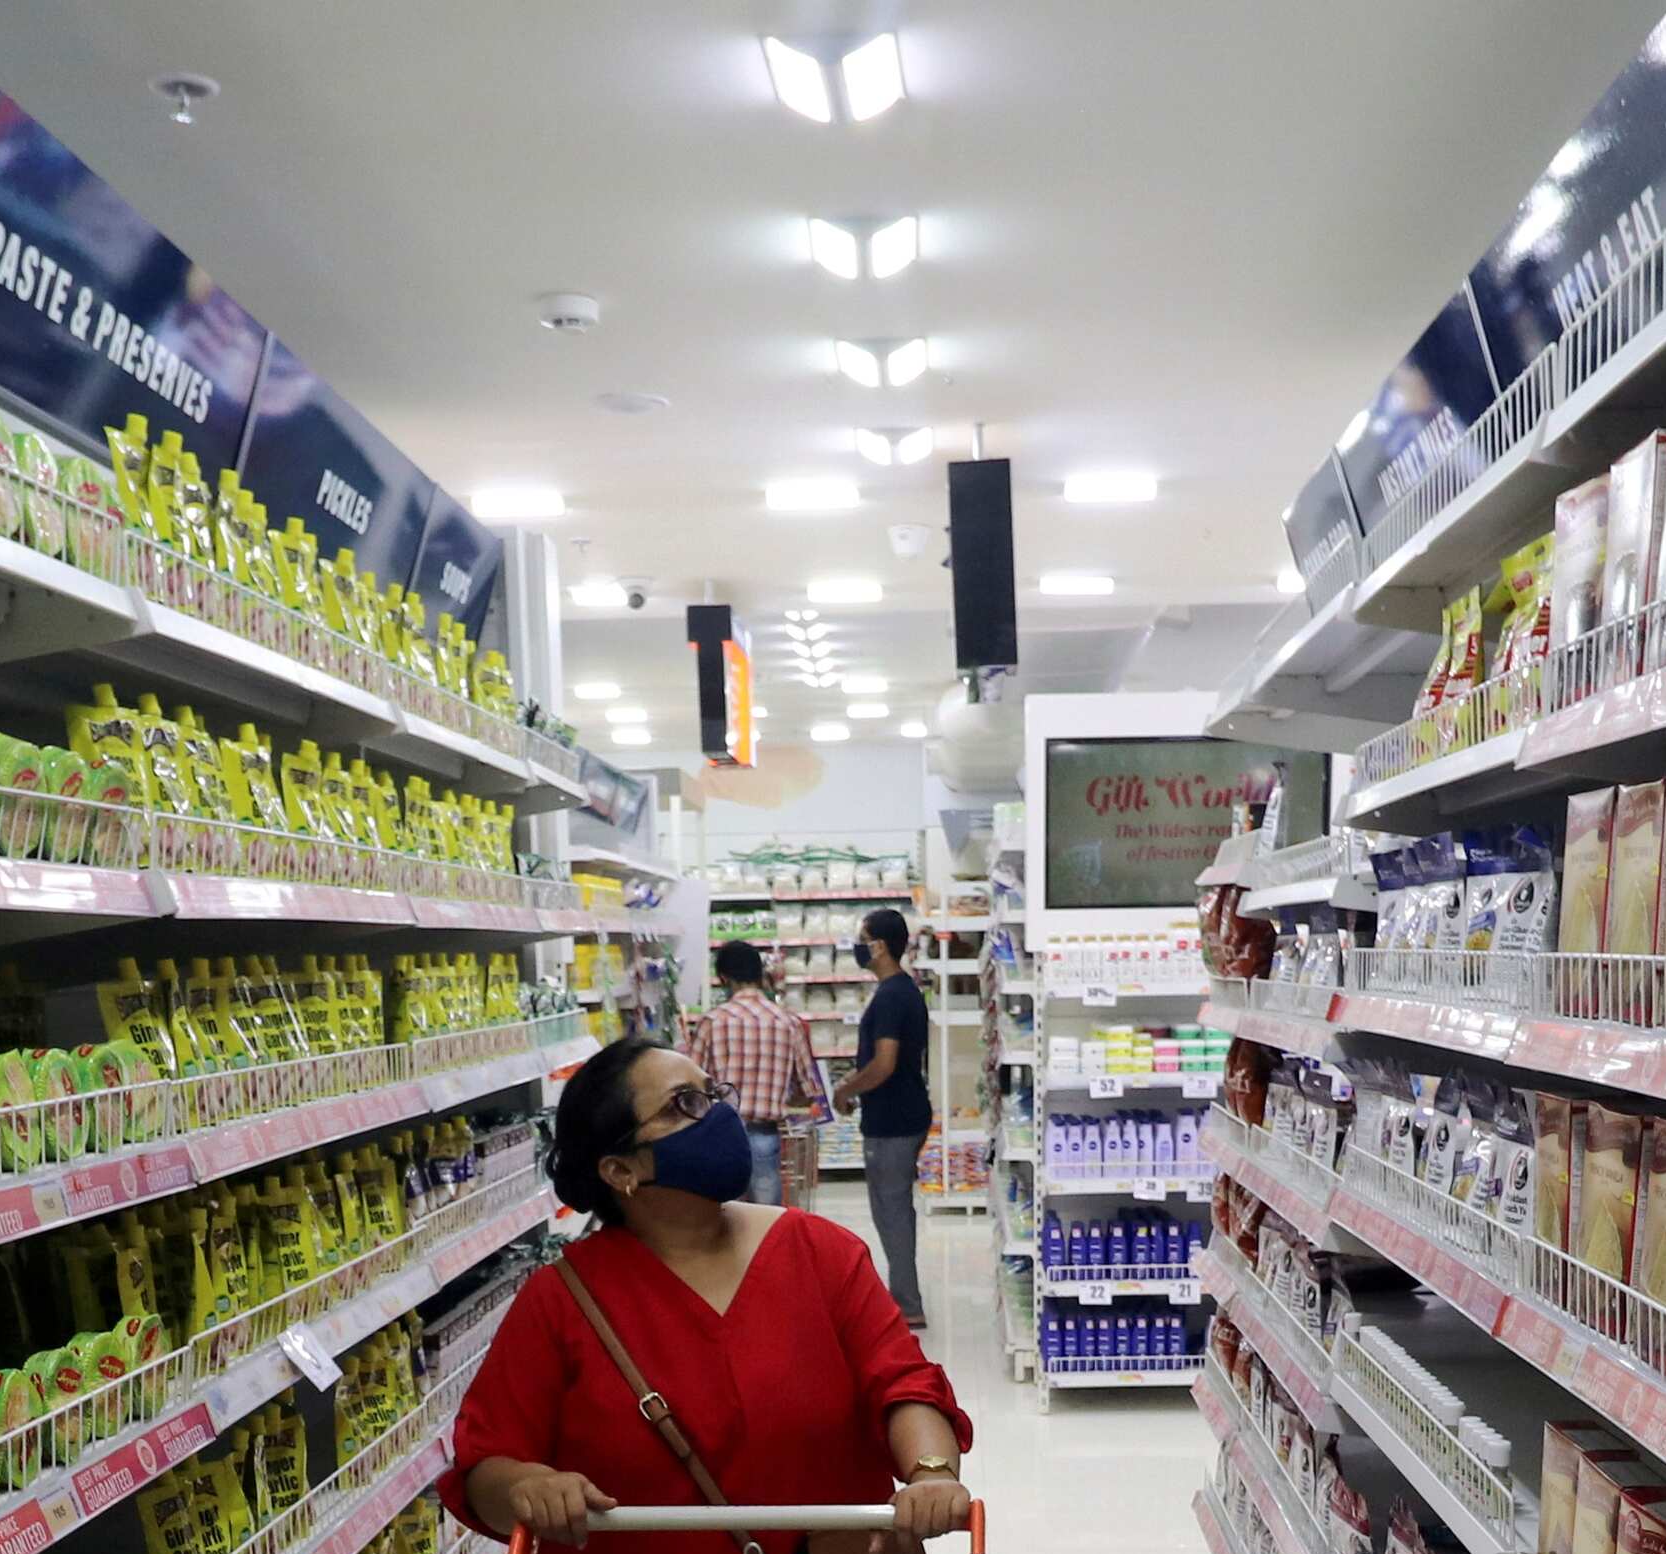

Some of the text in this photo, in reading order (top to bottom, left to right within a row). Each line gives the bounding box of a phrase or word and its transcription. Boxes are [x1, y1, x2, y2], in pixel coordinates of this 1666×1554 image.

[1600, 234, 1621, 283] &
[1617, 186, 1662, 266] EAT
[69, 285, 92, 339] &
[92, 300, 215, 425] PRESERVES
[1377, 405, 1459, 507] INSTANT MIXES
[316, 470, 374, 534] PICKLES
[439, 560, 470, 605] SOUPS
[1086, 774, 1149, 816] Gift
[1116, 824, 1141, 838] The
[1148, 824, 1202, 838] Widest
[1100, 1079, 1116, 1093] 52
[1089, 1286, 1105, 1299] 22
[1178, 1284, 1192, 1297] 21
